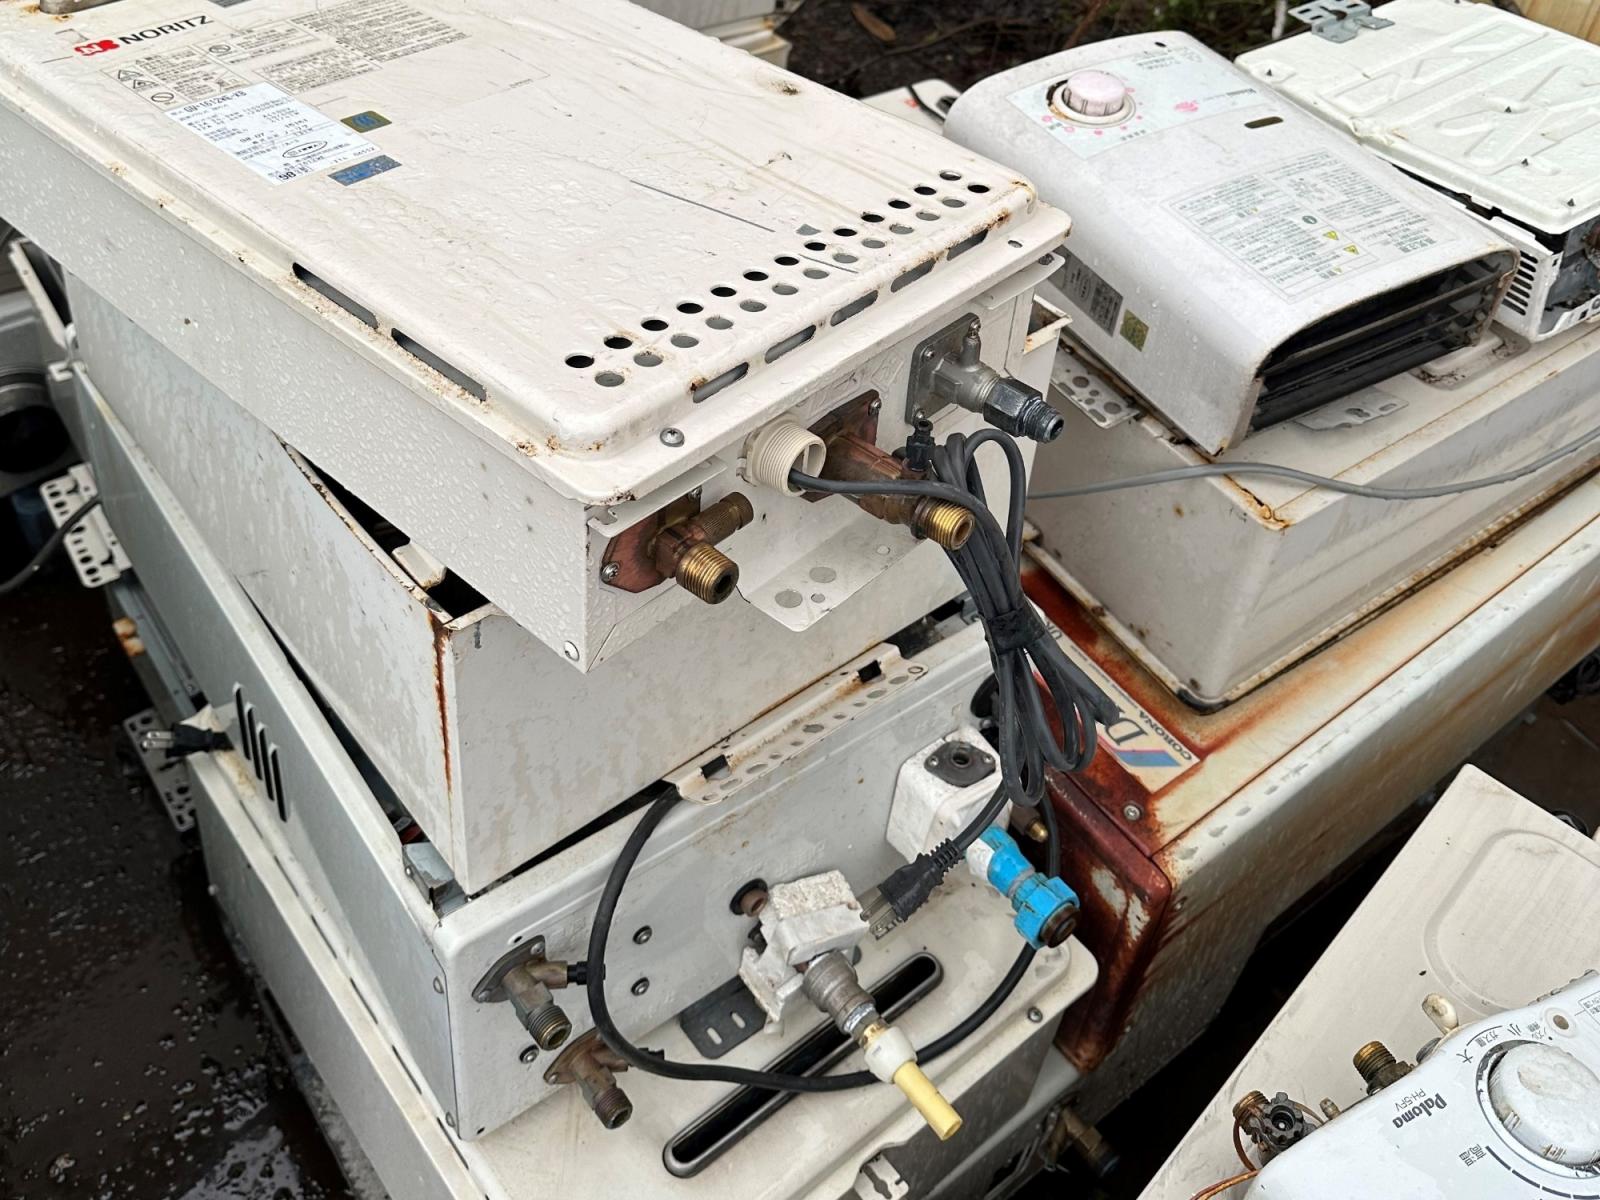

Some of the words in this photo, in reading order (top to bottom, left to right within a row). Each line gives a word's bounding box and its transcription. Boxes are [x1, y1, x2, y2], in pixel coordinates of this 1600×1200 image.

[118, 15, 215, 45] NORITZ
[1139, 711, 1192, 760] CORONA
[1507, 1023, 1522, 1036] 小
[1456, 1048, 1474, 1063] 大
[1392, 1092, 1447, 1128] Paloma
[1458, 1143, 1487, 1167] 高温
